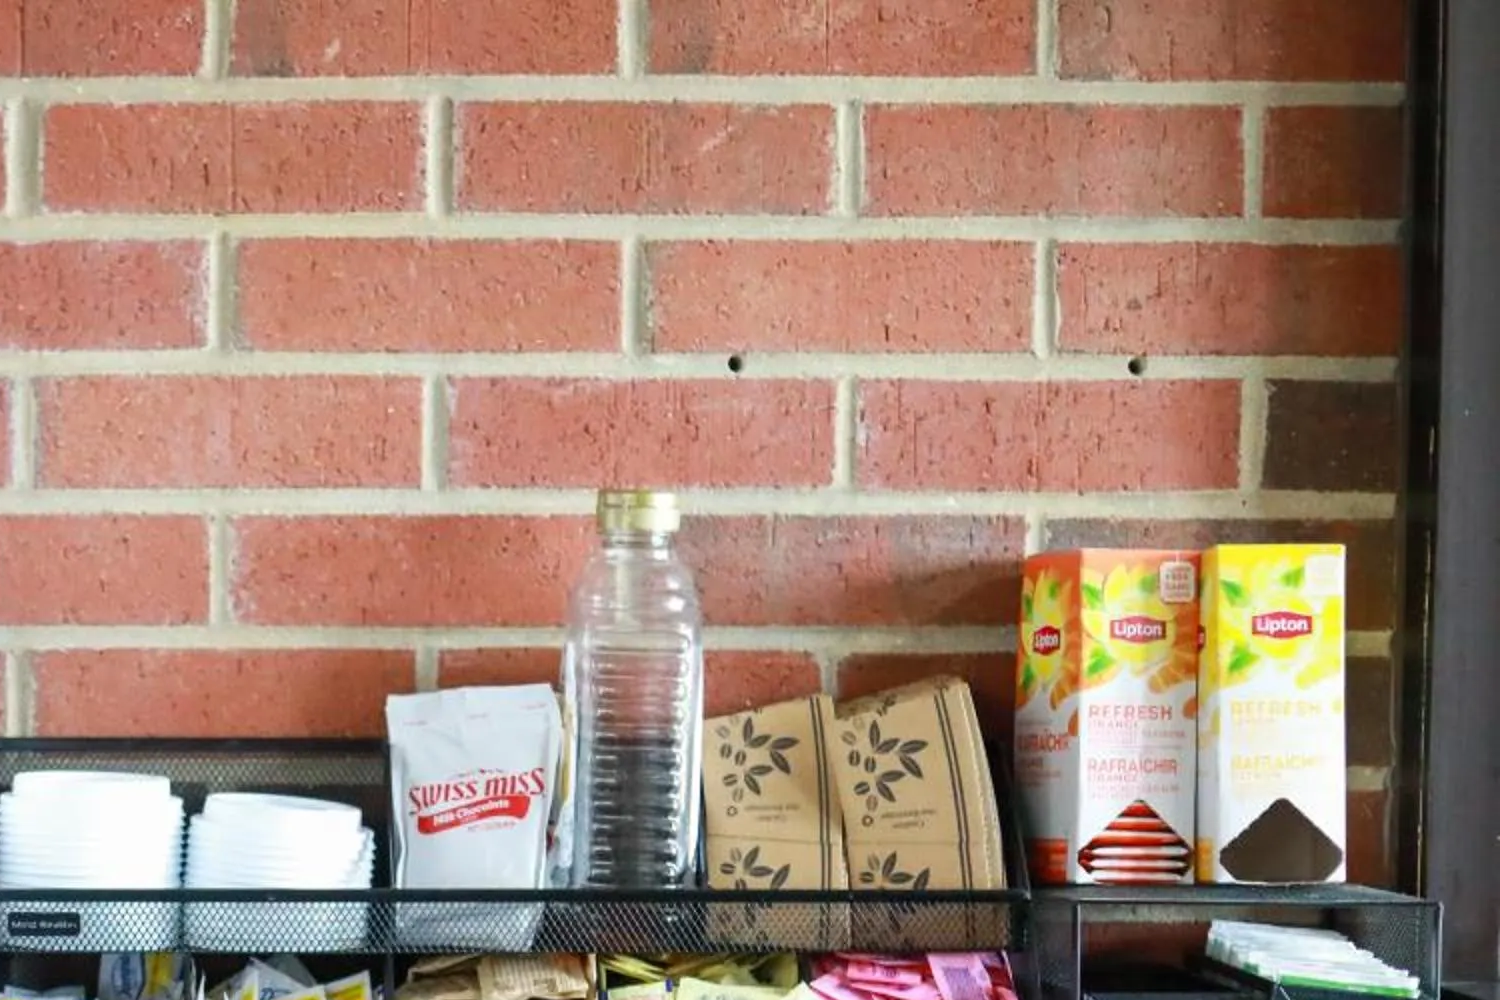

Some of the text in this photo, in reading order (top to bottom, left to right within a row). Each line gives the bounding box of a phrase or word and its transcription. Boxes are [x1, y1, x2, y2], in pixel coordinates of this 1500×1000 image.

[1113, 622, 1163, 640] Lipton
[1256, 616, 1309, 634] Lipton
[409, 781, 478, 816] SWISS
